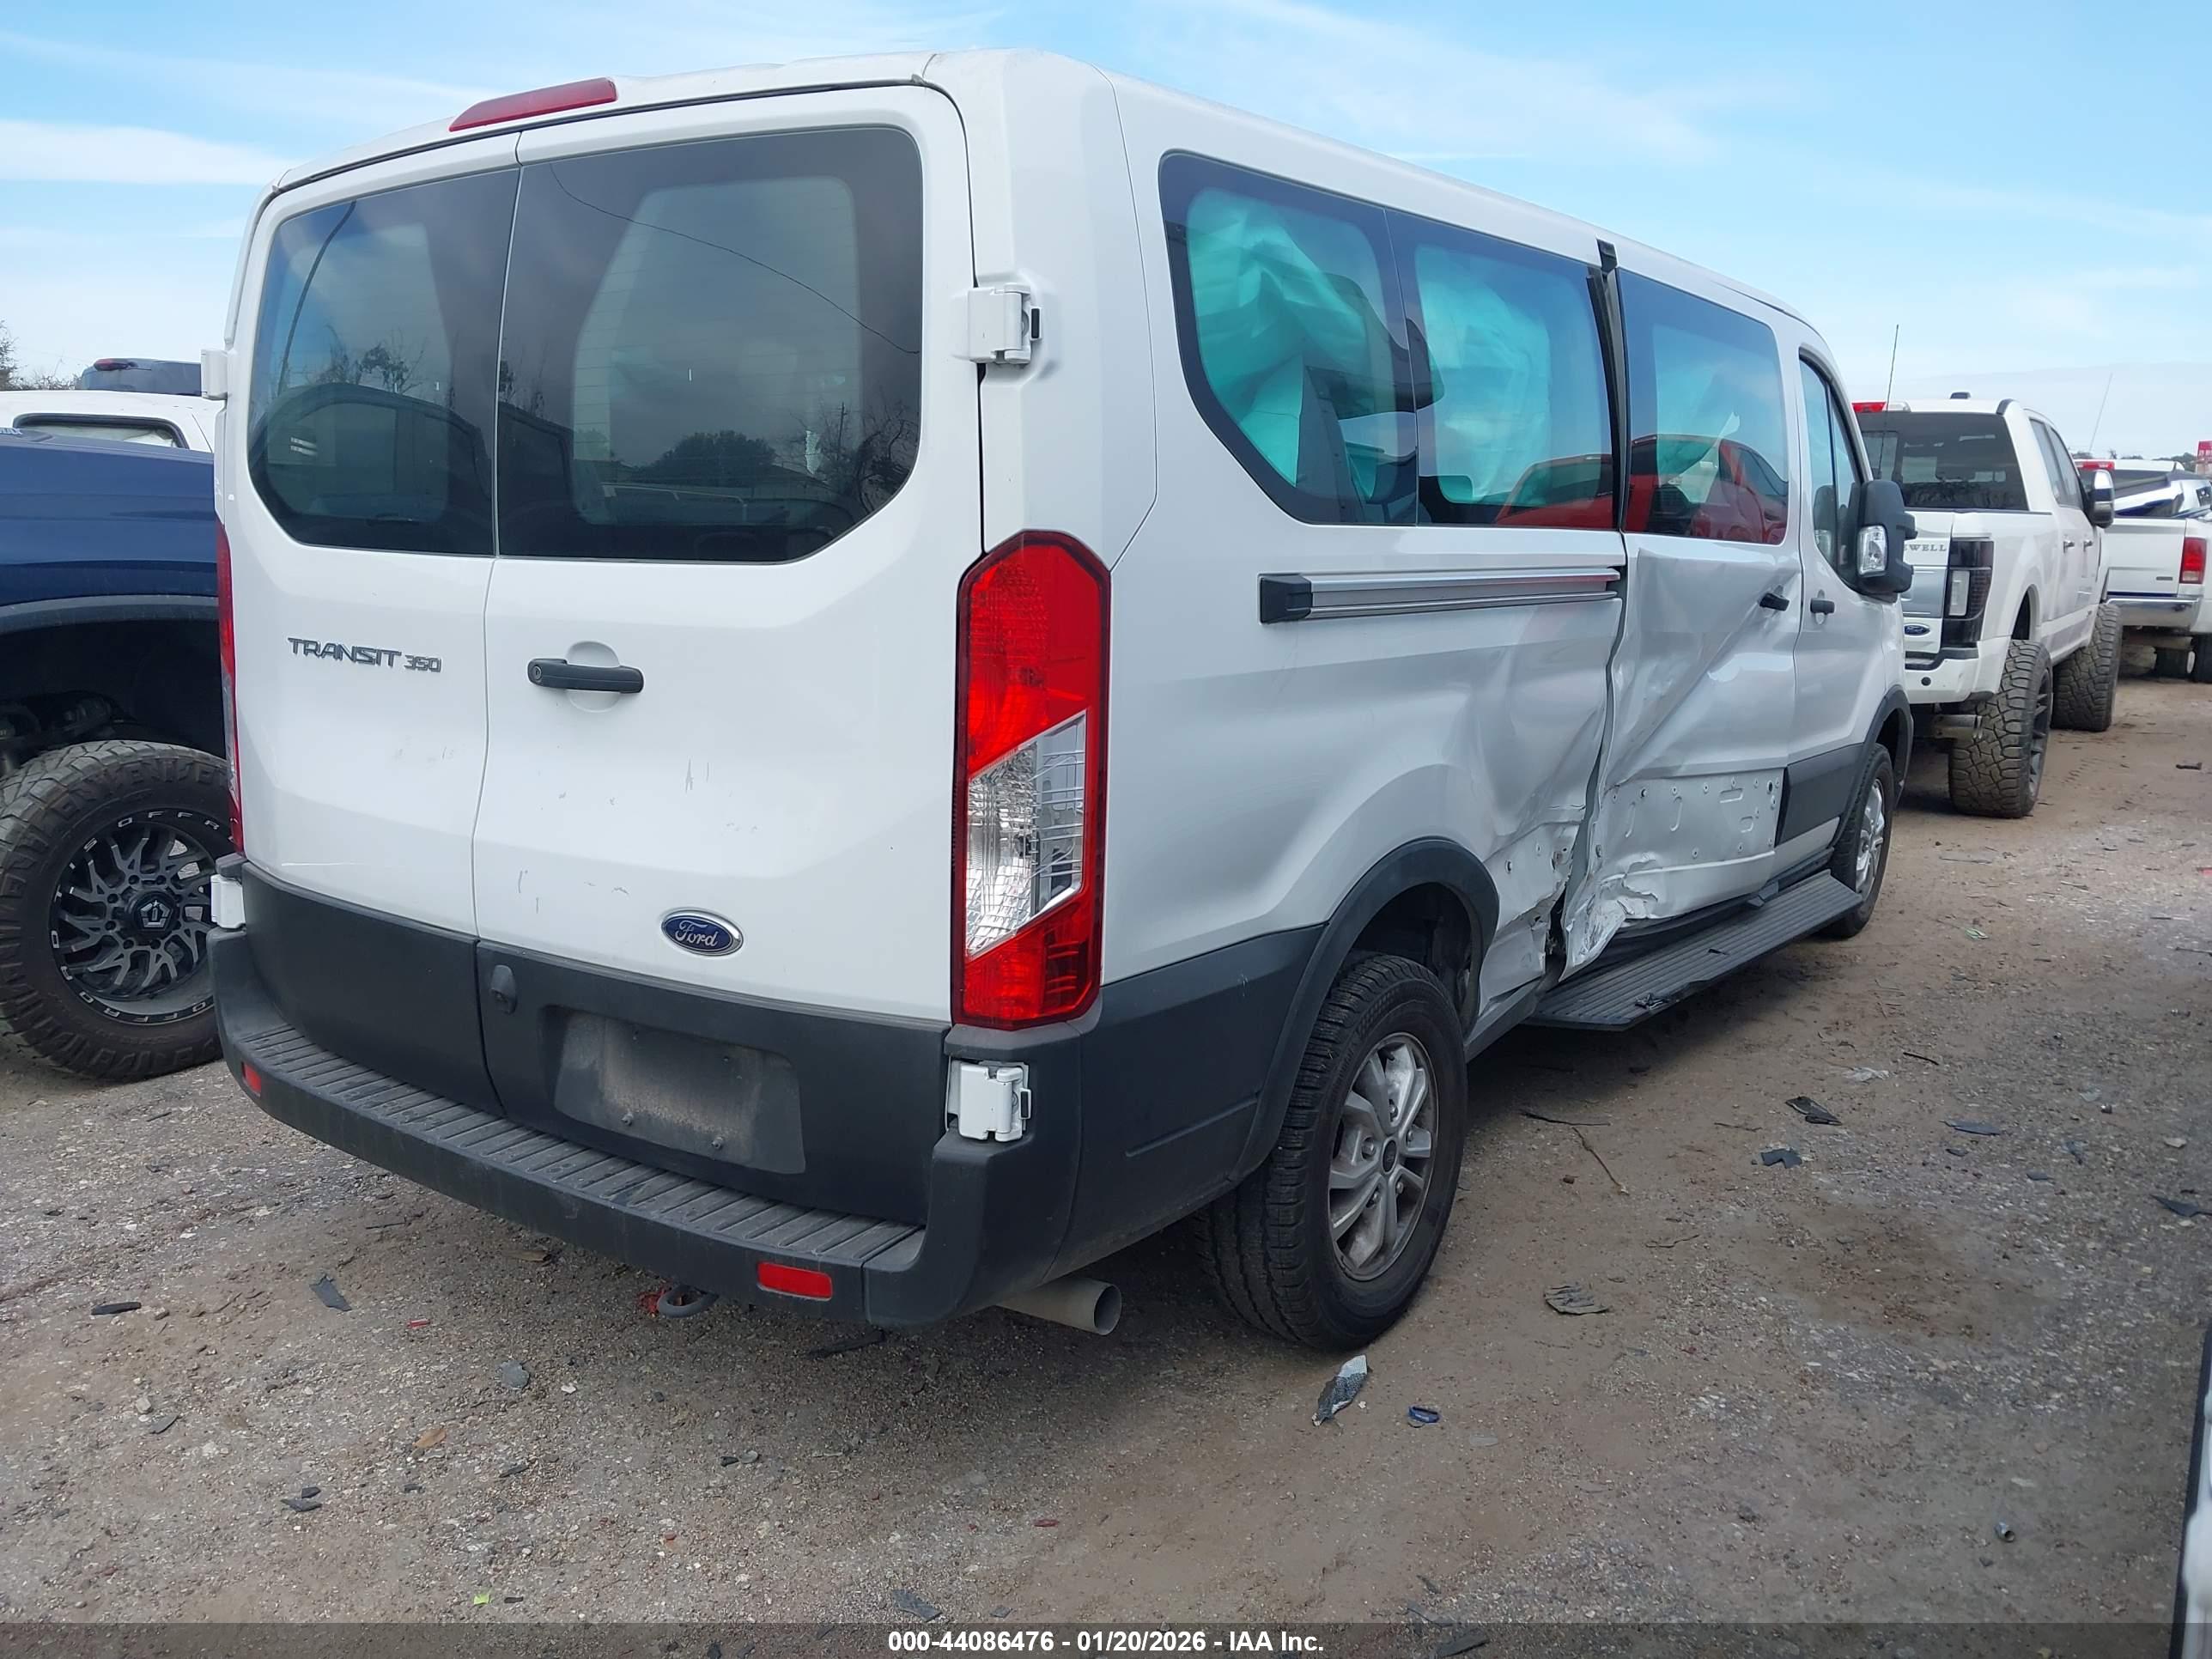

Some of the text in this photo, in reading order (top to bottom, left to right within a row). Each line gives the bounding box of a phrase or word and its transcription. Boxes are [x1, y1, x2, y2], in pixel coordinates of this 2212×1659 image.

[288, 637, 441, 672] TRANSIT 350
[675, 920, 719, 947] Ford
